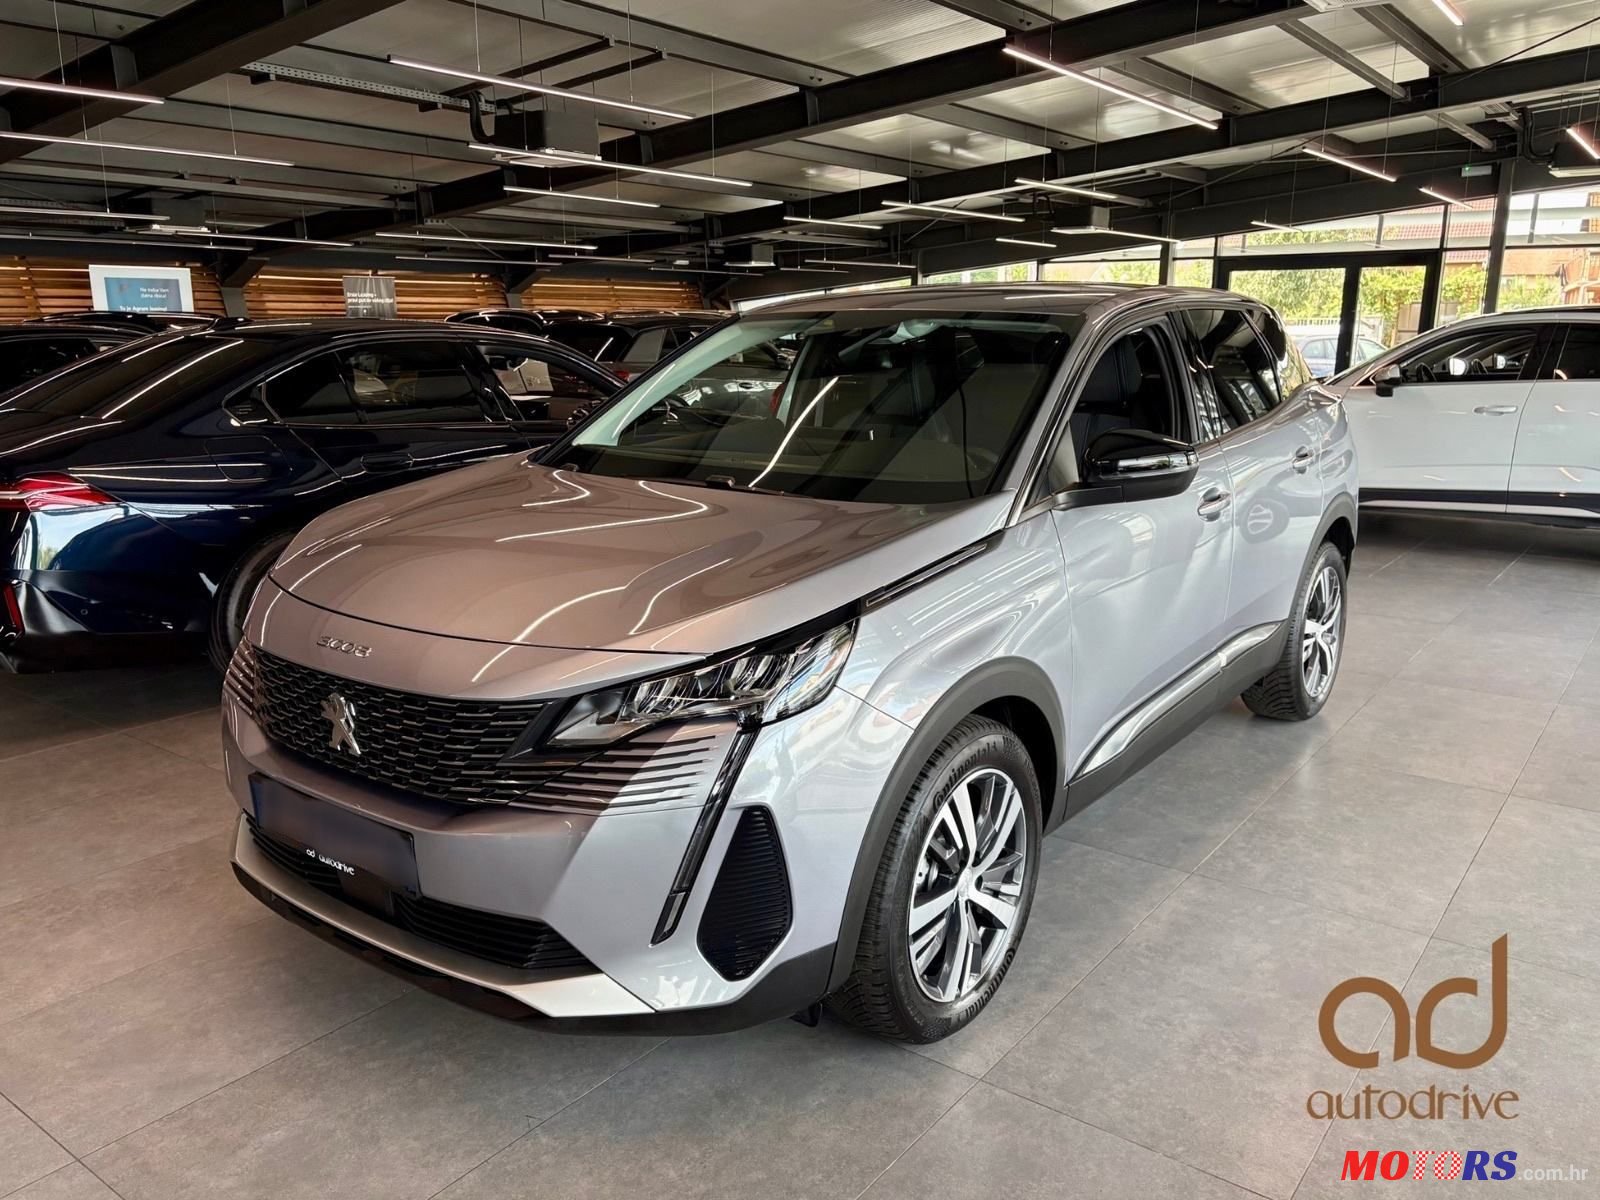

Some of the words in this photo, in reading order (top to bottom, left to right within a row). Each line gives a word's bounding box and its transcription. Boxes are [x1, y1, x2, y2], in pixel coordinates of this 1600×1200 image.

[317, 635, 373, 658] 3008
[932, 741, 990, 812] Continental
[319, 853, 355, 876] autodrive
